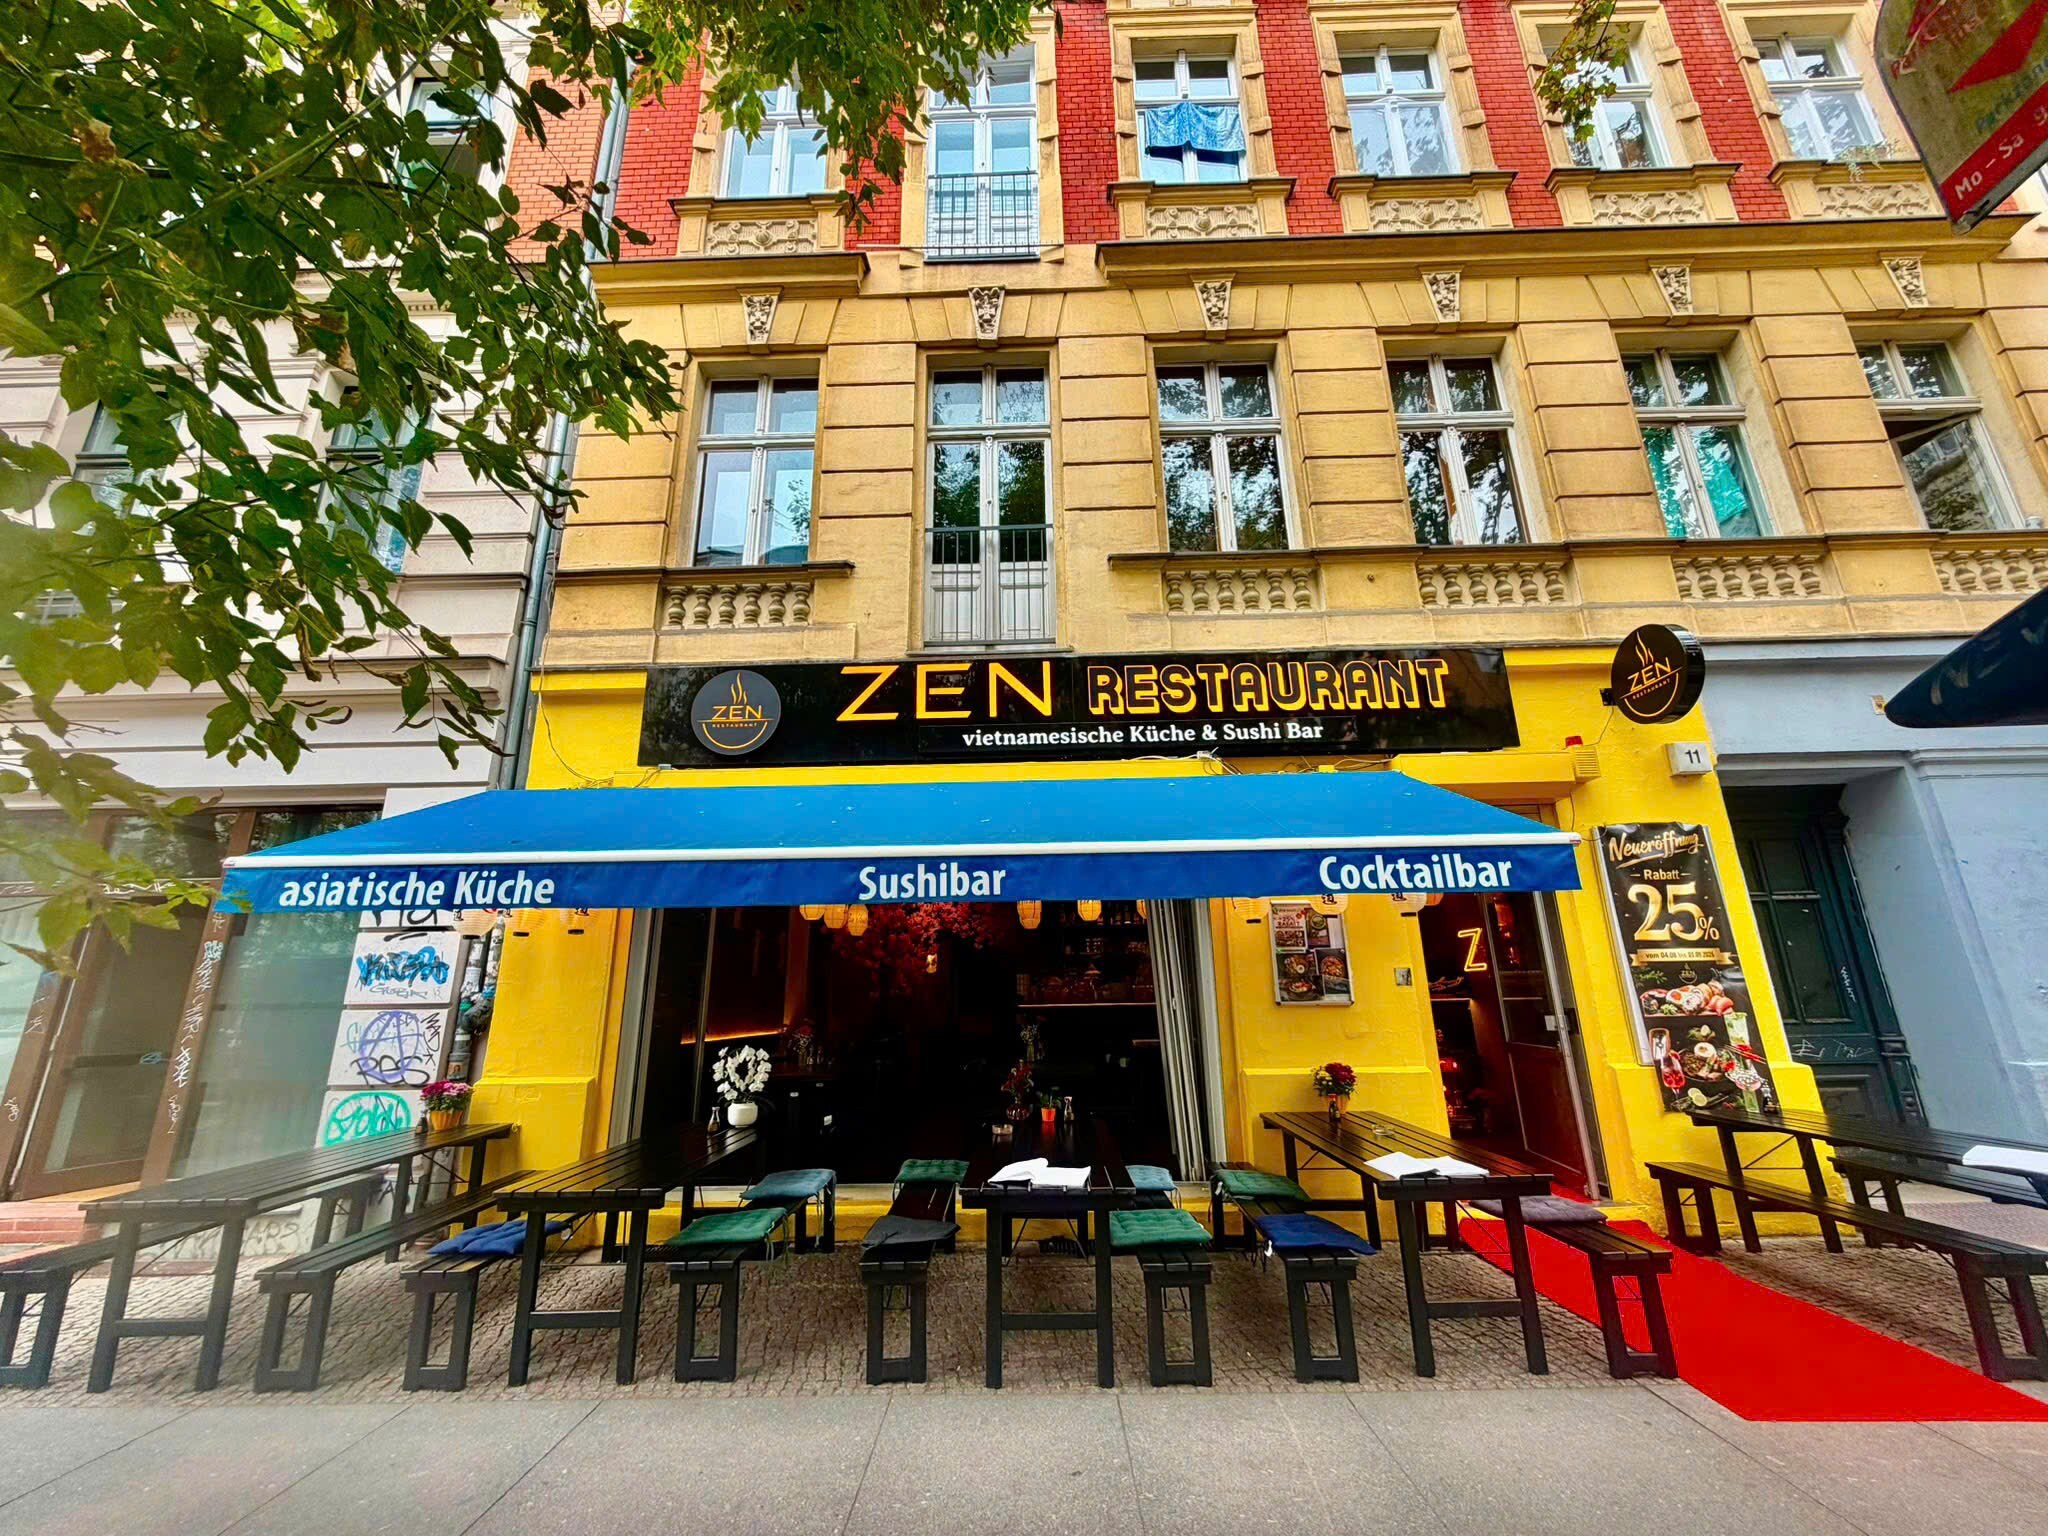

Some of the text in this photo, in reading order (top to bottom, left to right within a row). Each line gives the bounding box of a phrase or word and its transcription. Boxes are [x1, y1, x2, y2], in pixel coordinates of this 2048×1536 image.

[1954, 171, 1983, 200] Mo
[1998, 134, 2024, 159] Sa
[836, 658, 1449, 721] ZEN RESTAURANT
[1627, 656, 1672, 692] ZEN
[1632, 678, 1670, 700] RESTAURANT
[711, 704, 762, 720] ZEN
[962, 721, 1324, 747] vietnamesische Küche & Sushi Bar
[1685, 749, 1701, 764] 11
[279, 870, 555, 907] asiatische Küche
[858, 862, 1006, 900] Sushibar
[1319, 853, 1512, 891] Cocktailbar
[1643, 869, 1680, 881] Rabatt
[1627, 881, 1720, 941] 25%
[1457, 927, 1488, 972] Z
